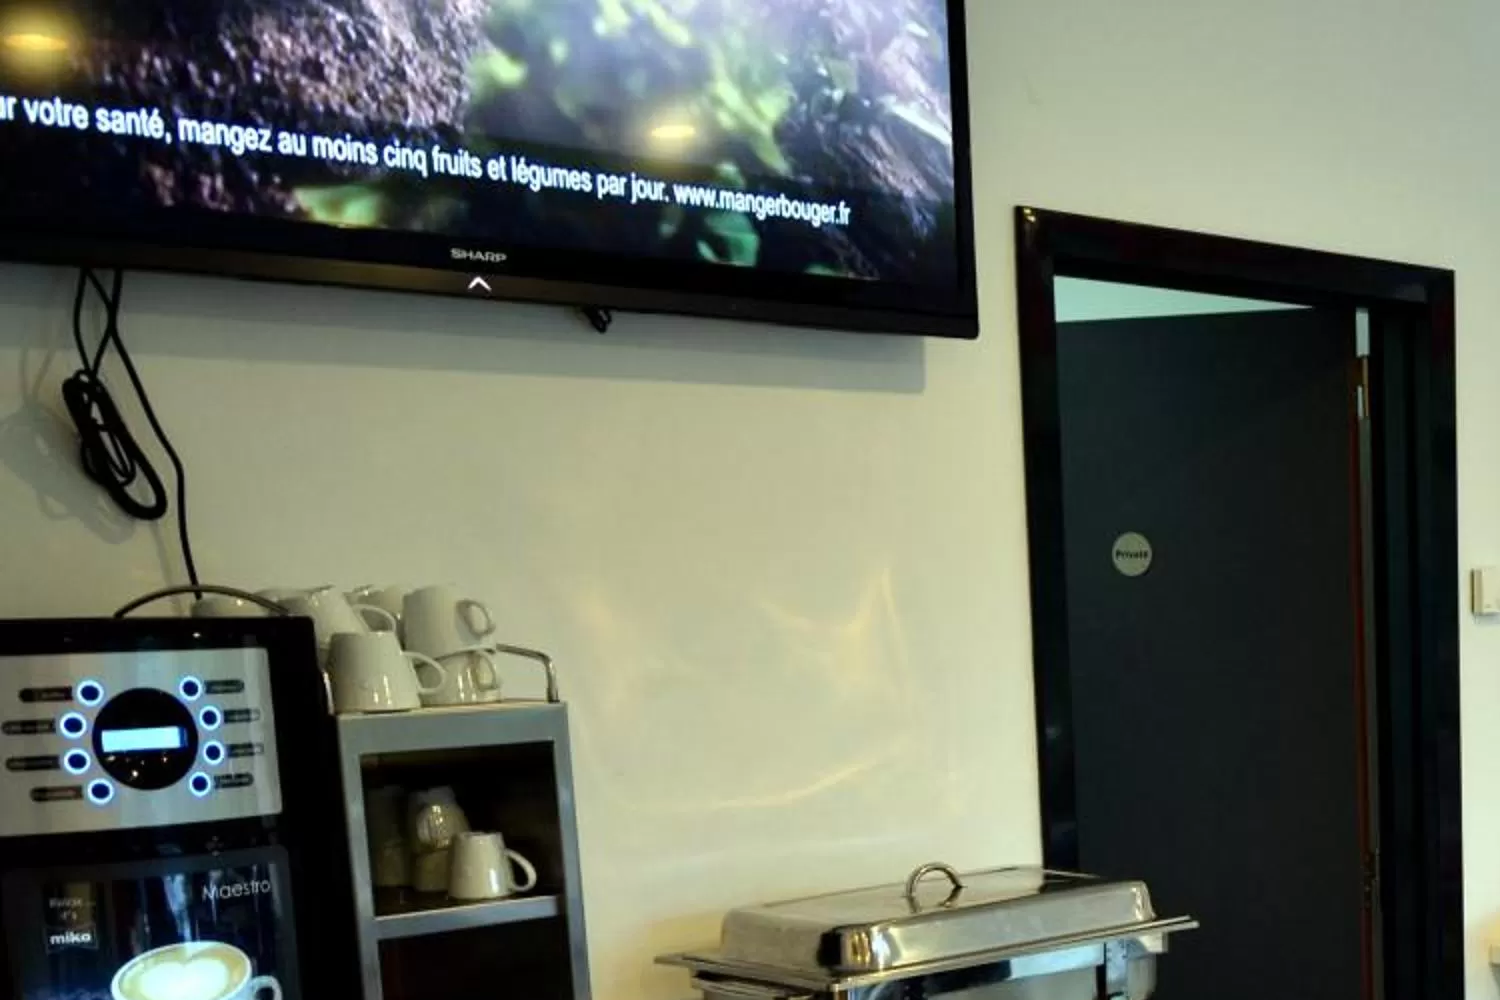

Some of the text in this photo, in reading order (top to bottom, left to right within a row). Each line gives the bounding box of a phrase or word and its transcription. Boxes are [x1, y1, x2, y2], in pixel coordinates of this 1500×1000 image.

[22, 95, 89, 130] votre
[96, 104, 172, 144] santé,
[178, 116, 272, 156] mangez
[278, 132, 306, 156] au
[313, 133, 378, 166] moins
[383, 143, 428, 178] cinq
[431, 143, 482, 180] fruits
[487, 156, 507, 181] et
[511, 156, 592, 193] légumes
[597, 172, 626, 200] par
[631, 174, 669, 203] jour.
[673, 182, 851, 227] www.mangerbouger.fr
[450, 247, 507, 263] SHARP
[202, 879, 271, 902] Maestro
[50, 931, 91, 945] miko
